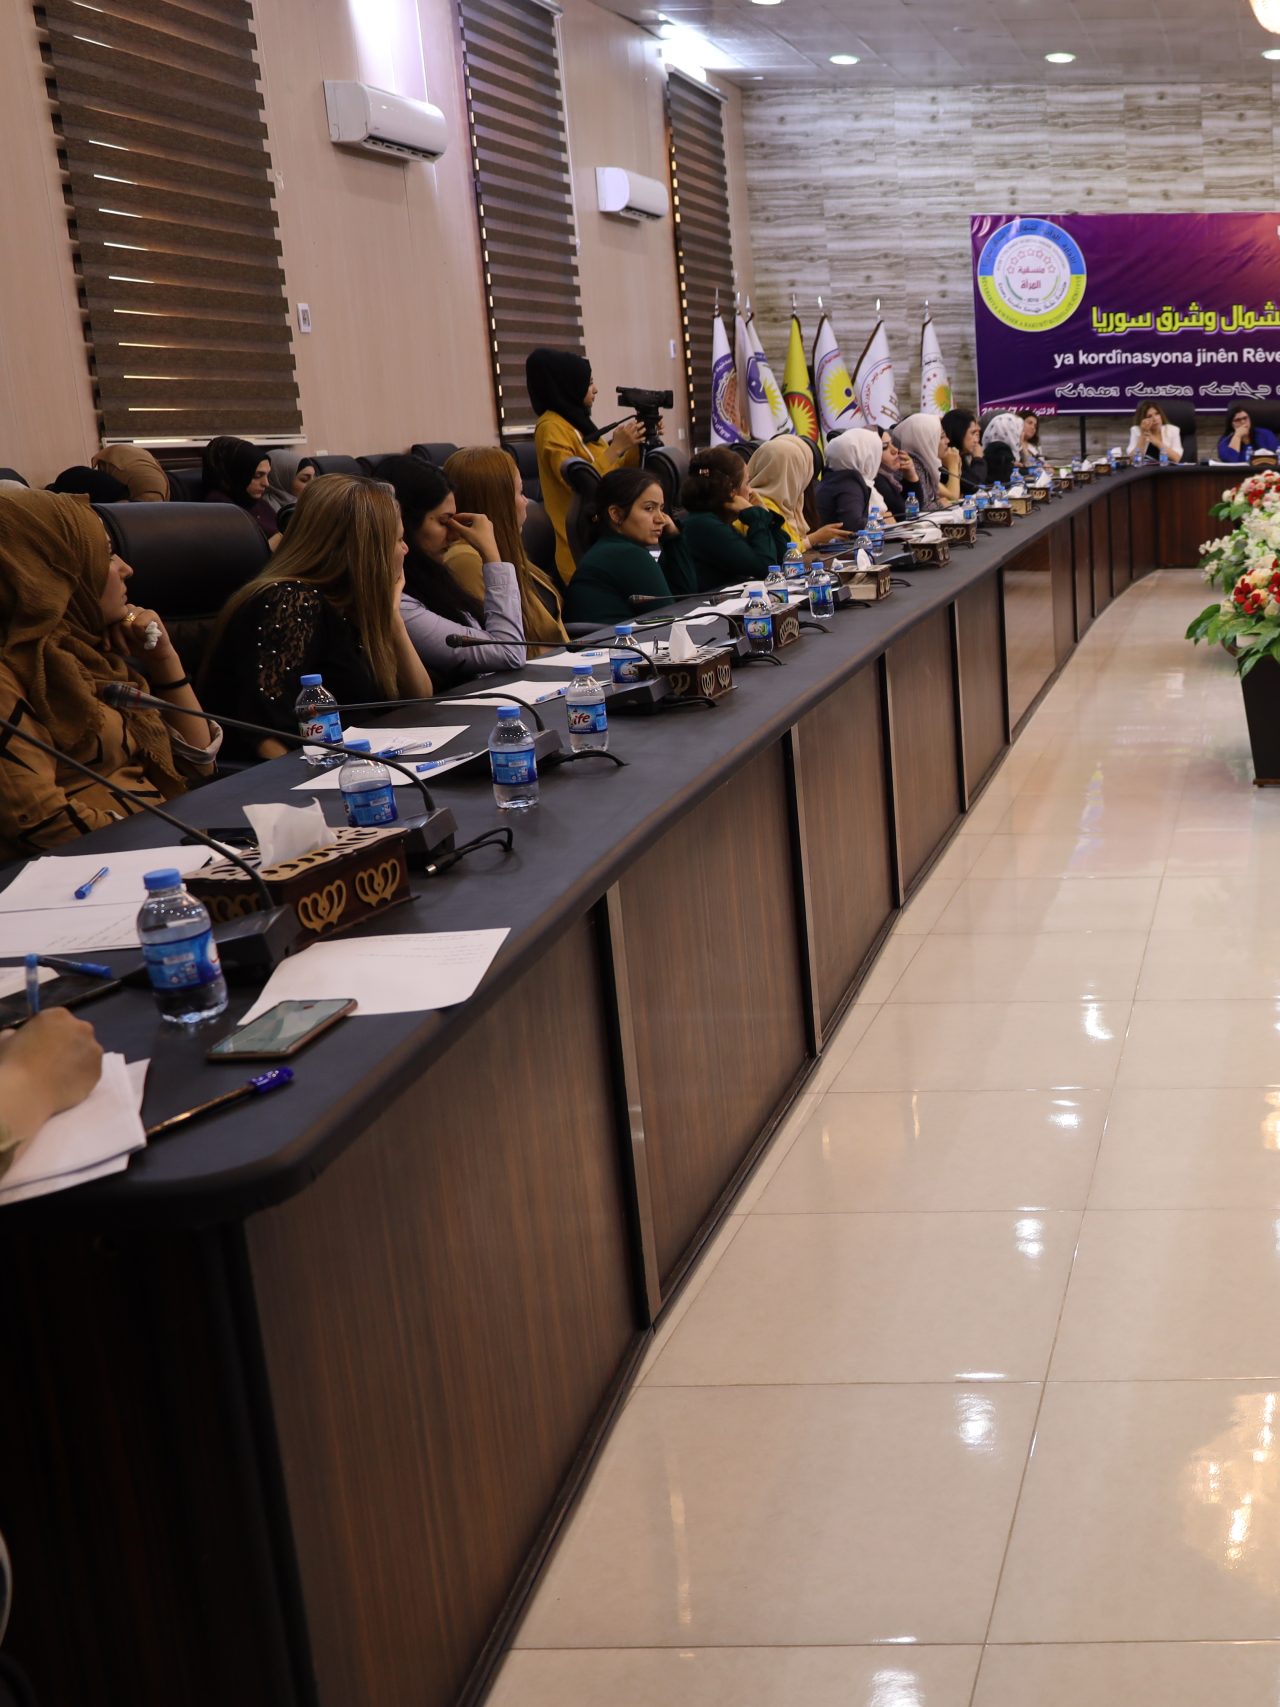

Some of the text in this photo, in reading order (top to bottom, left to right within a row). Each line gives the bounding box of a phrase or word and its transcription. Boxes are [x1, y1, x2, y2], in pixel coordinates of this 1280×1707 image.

[1091, 305, 1152, 333] سوريا
[1156, 302, 1217, 333] وشرق
[1054, 352, 1074, 368] ya
[1195, 348, 1238, 367] jinên
